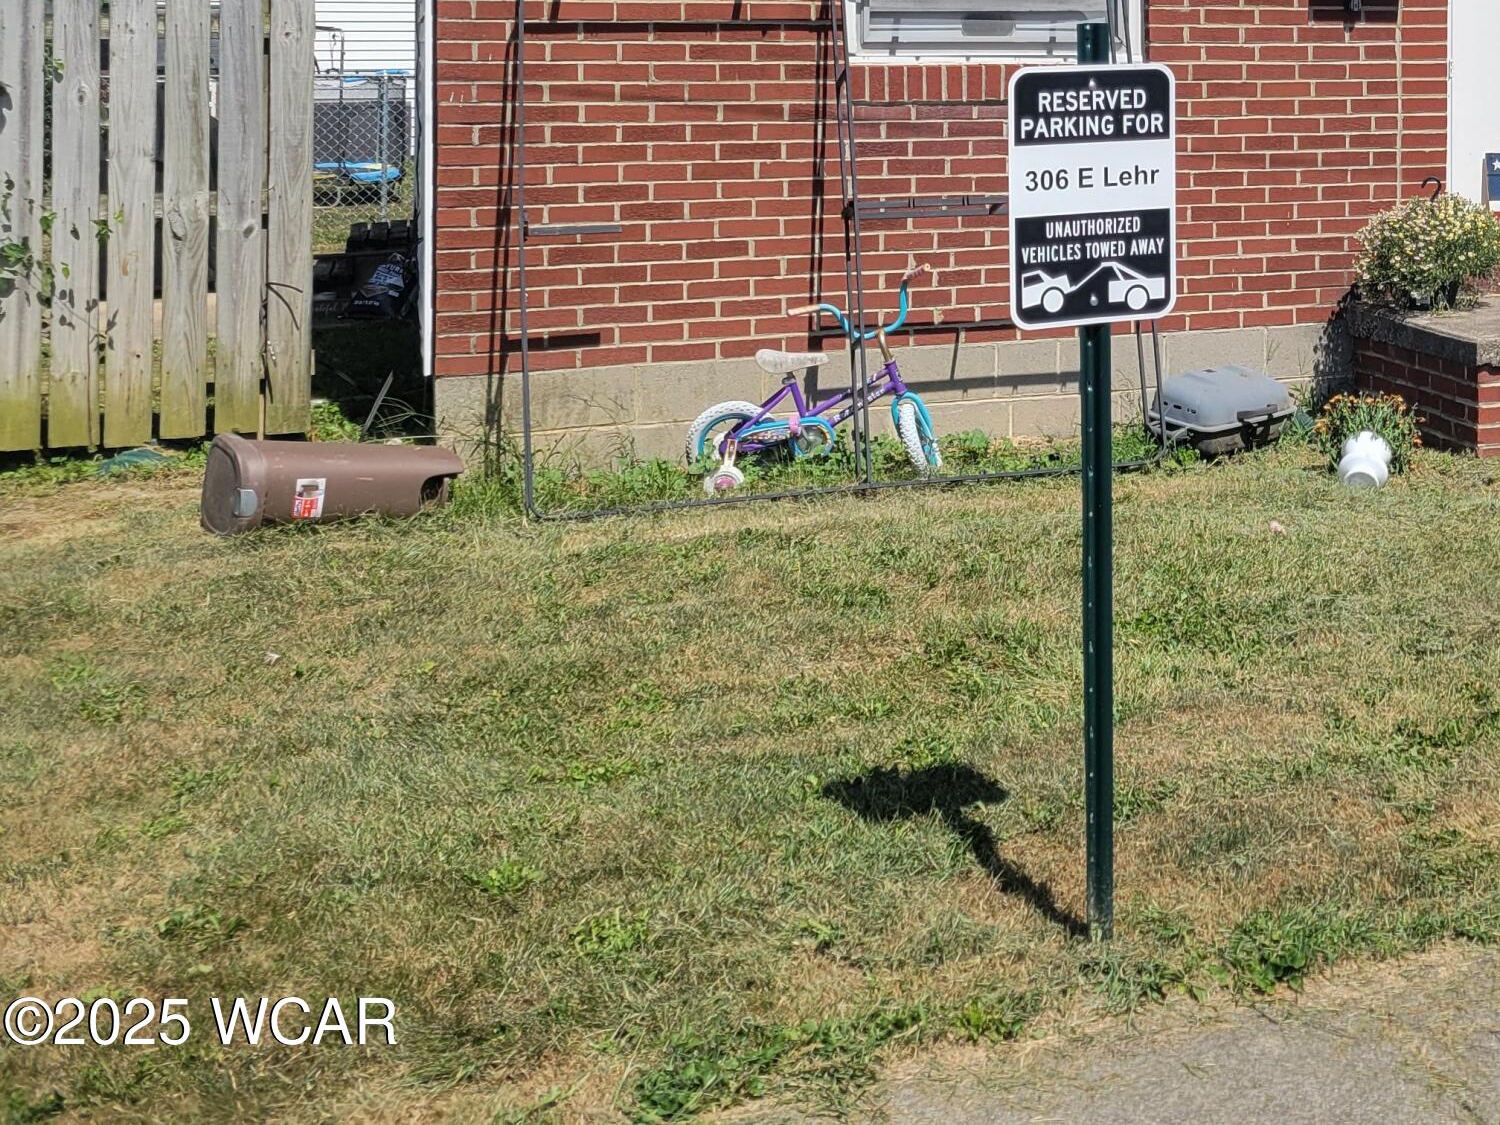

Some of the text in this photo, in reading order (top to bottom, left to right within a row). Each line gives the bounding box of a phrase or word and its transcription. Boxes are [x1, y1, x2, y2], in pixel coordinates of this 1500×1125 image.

[1038, 89, 1147, 113] RESERVED
[1020, 113, 1164, 140] PARKING FOR
[1025, 164, 1160, 192] 306 E Lehr
[1045, 216, 1141, 239] UNAUTHORIZED
[1021, 237, 1165, 265] VEHICLES TOWED AWAY
